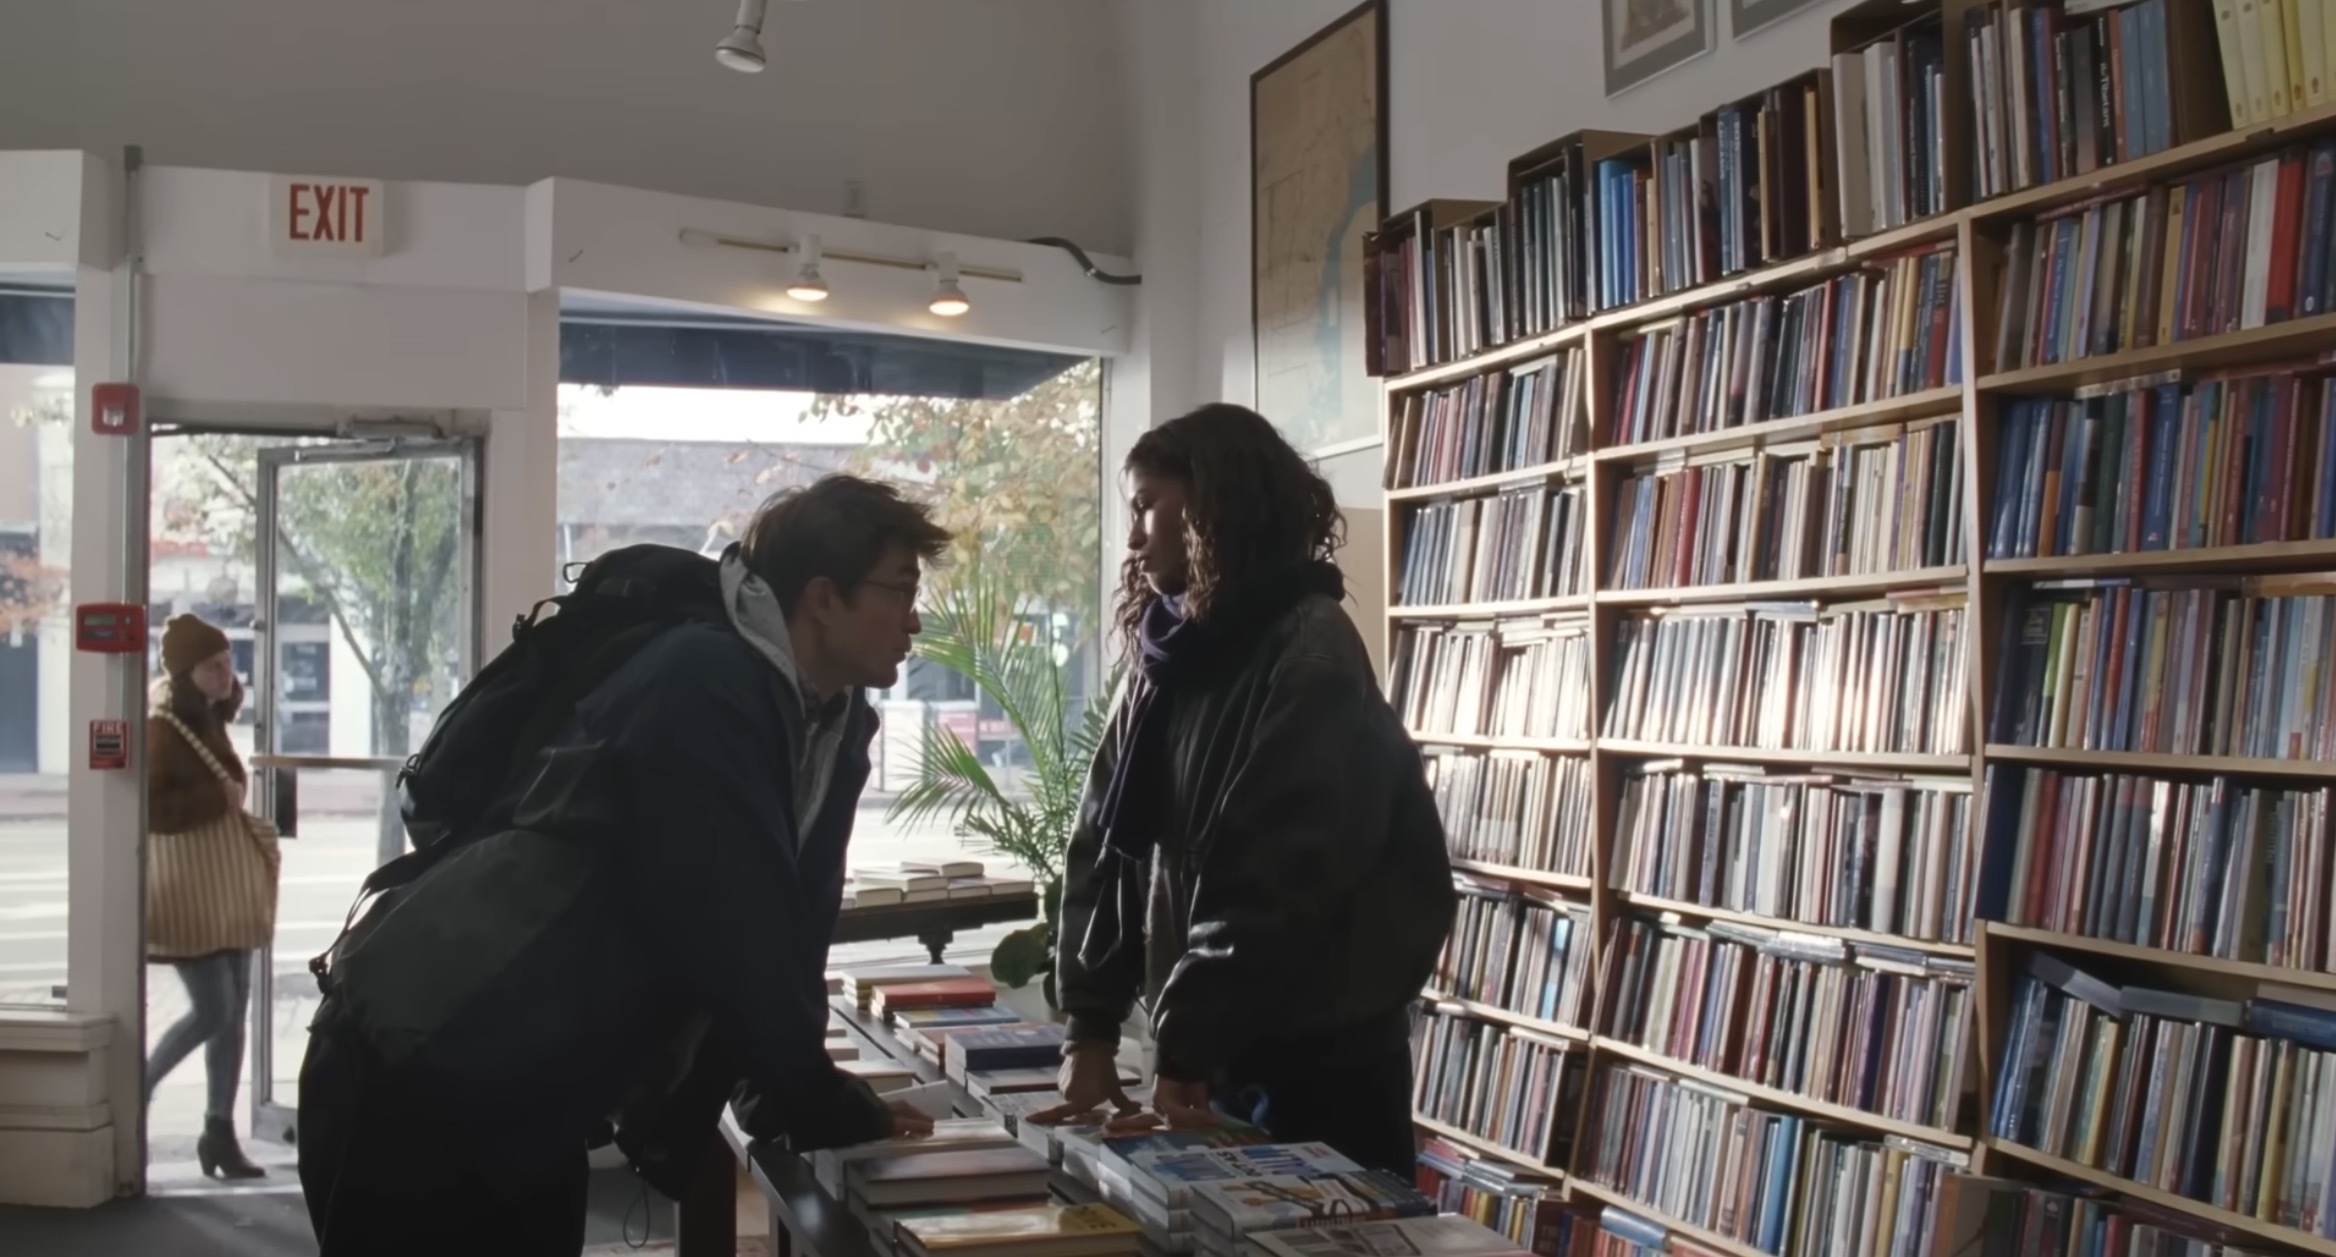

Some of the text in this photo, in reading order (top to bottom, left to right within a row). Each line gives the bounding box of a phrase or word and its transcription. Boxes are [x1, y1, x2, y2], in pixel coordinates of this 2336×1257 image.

[2100, 76, 2109, 128] Tibetans
[290, 184, 369, 242] EXIT
[94, 721, 122, 734] FIRE
